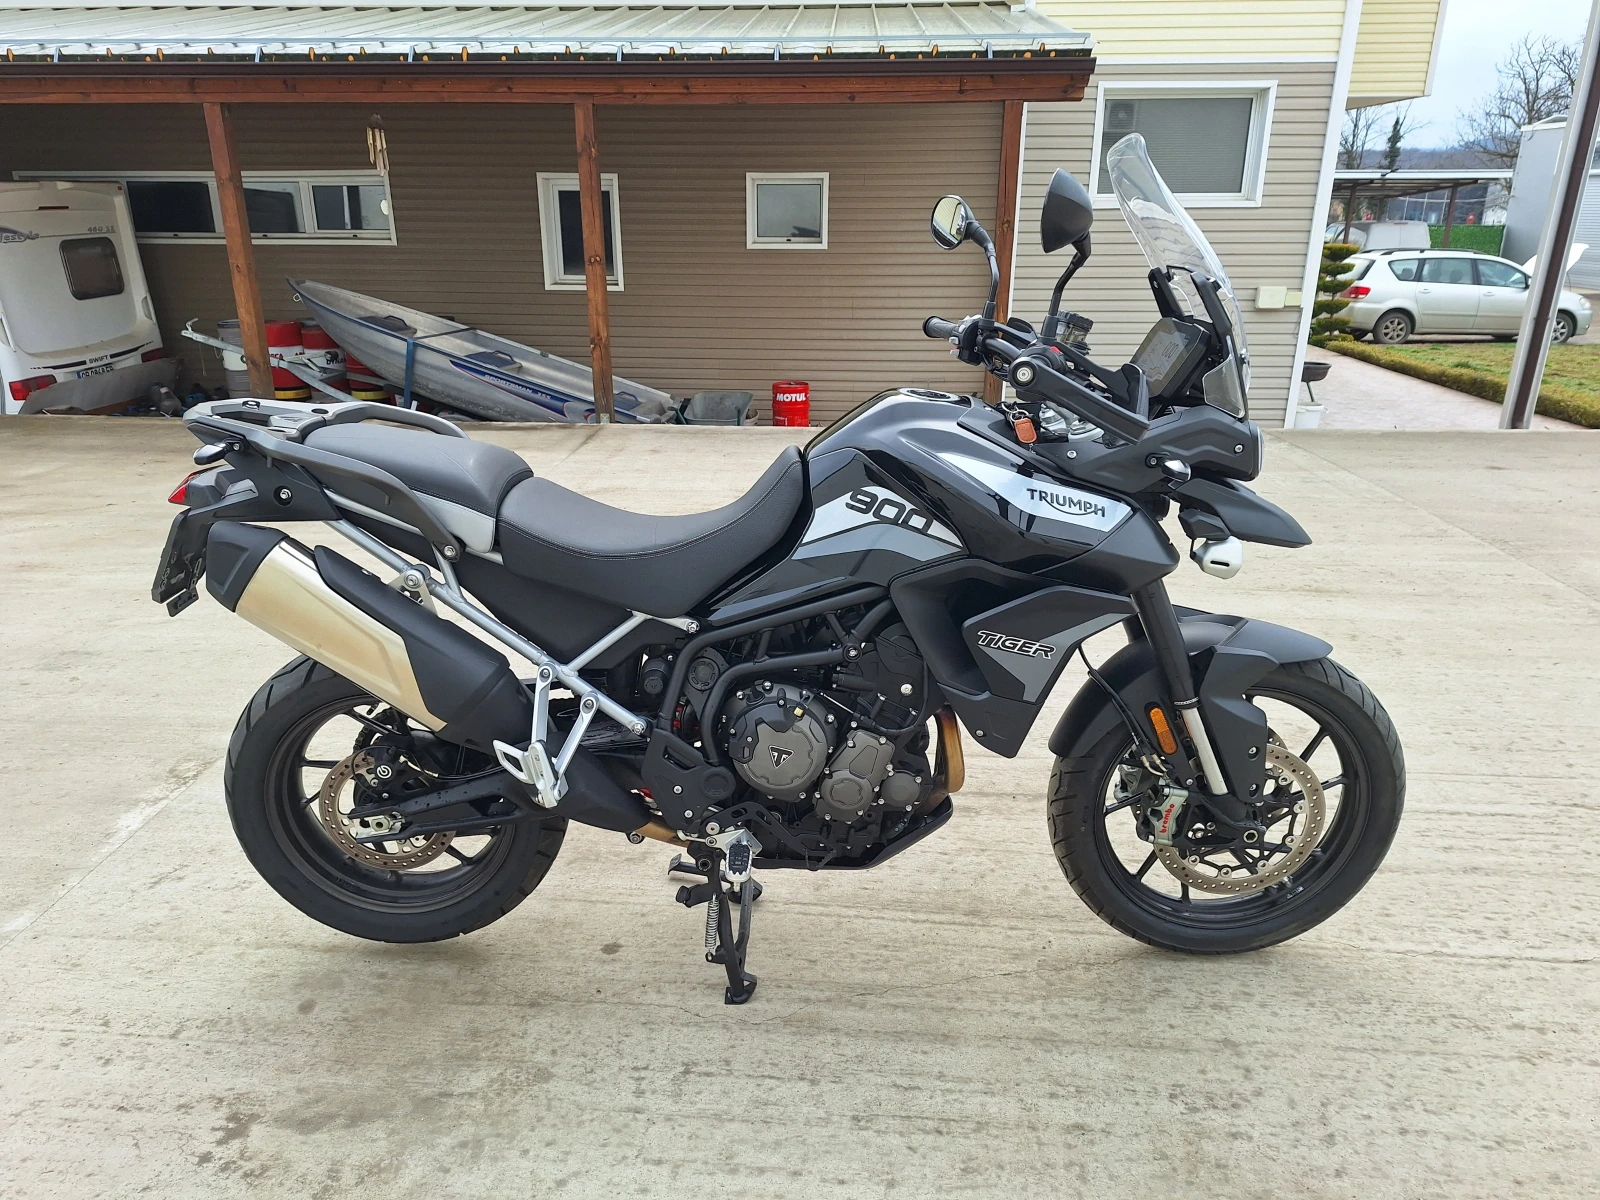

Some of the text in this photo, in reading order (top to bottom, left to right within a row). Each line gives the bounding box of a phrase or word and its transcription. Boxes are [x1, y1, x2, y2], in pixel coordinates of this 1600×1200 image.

[89, 354, 109, 364] SWIFT
[484, 374, 533, 394] SPORTSMAN
[776, 393, 806, 402] MOTUL
[845, 487, 935, 534] 900
[1026, 487, 1105, 517] TRIUMPH
[977, 630, 1057, 660] TIGER
[1159, 803, 1175, 834] brembo
